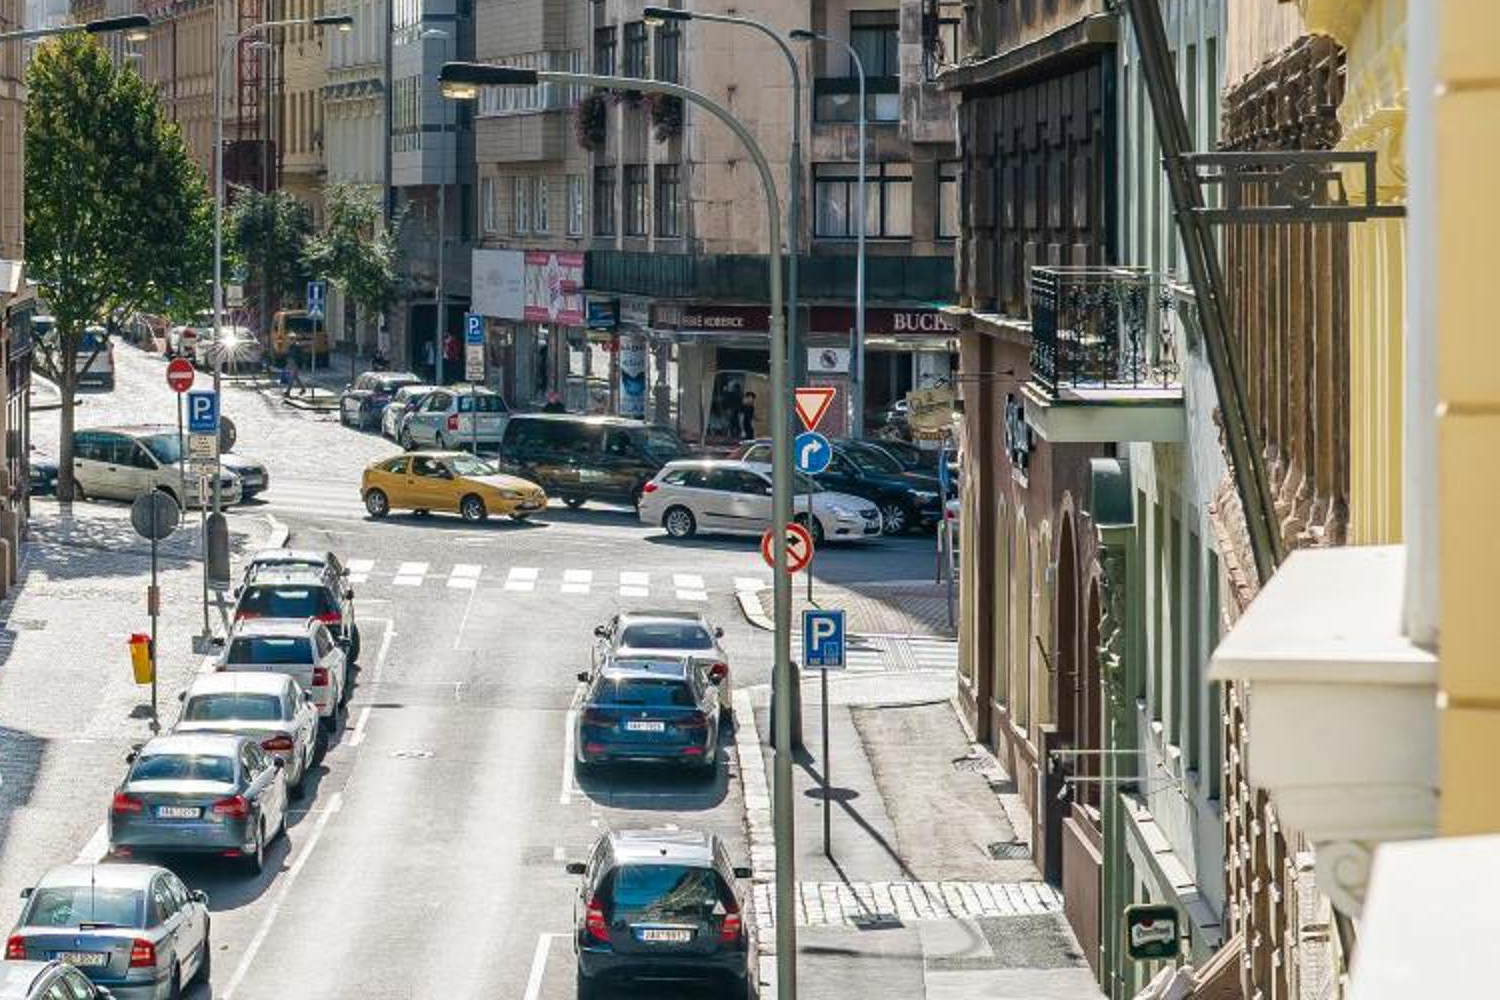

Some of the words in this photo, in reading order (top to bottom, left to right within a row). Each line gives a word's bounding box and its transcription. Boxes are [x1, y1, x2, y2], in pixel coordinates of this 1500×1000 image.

[469, 317, 479, 335] P
[193, 396, 211, 420] P
[812, 617, 836, 651] P
